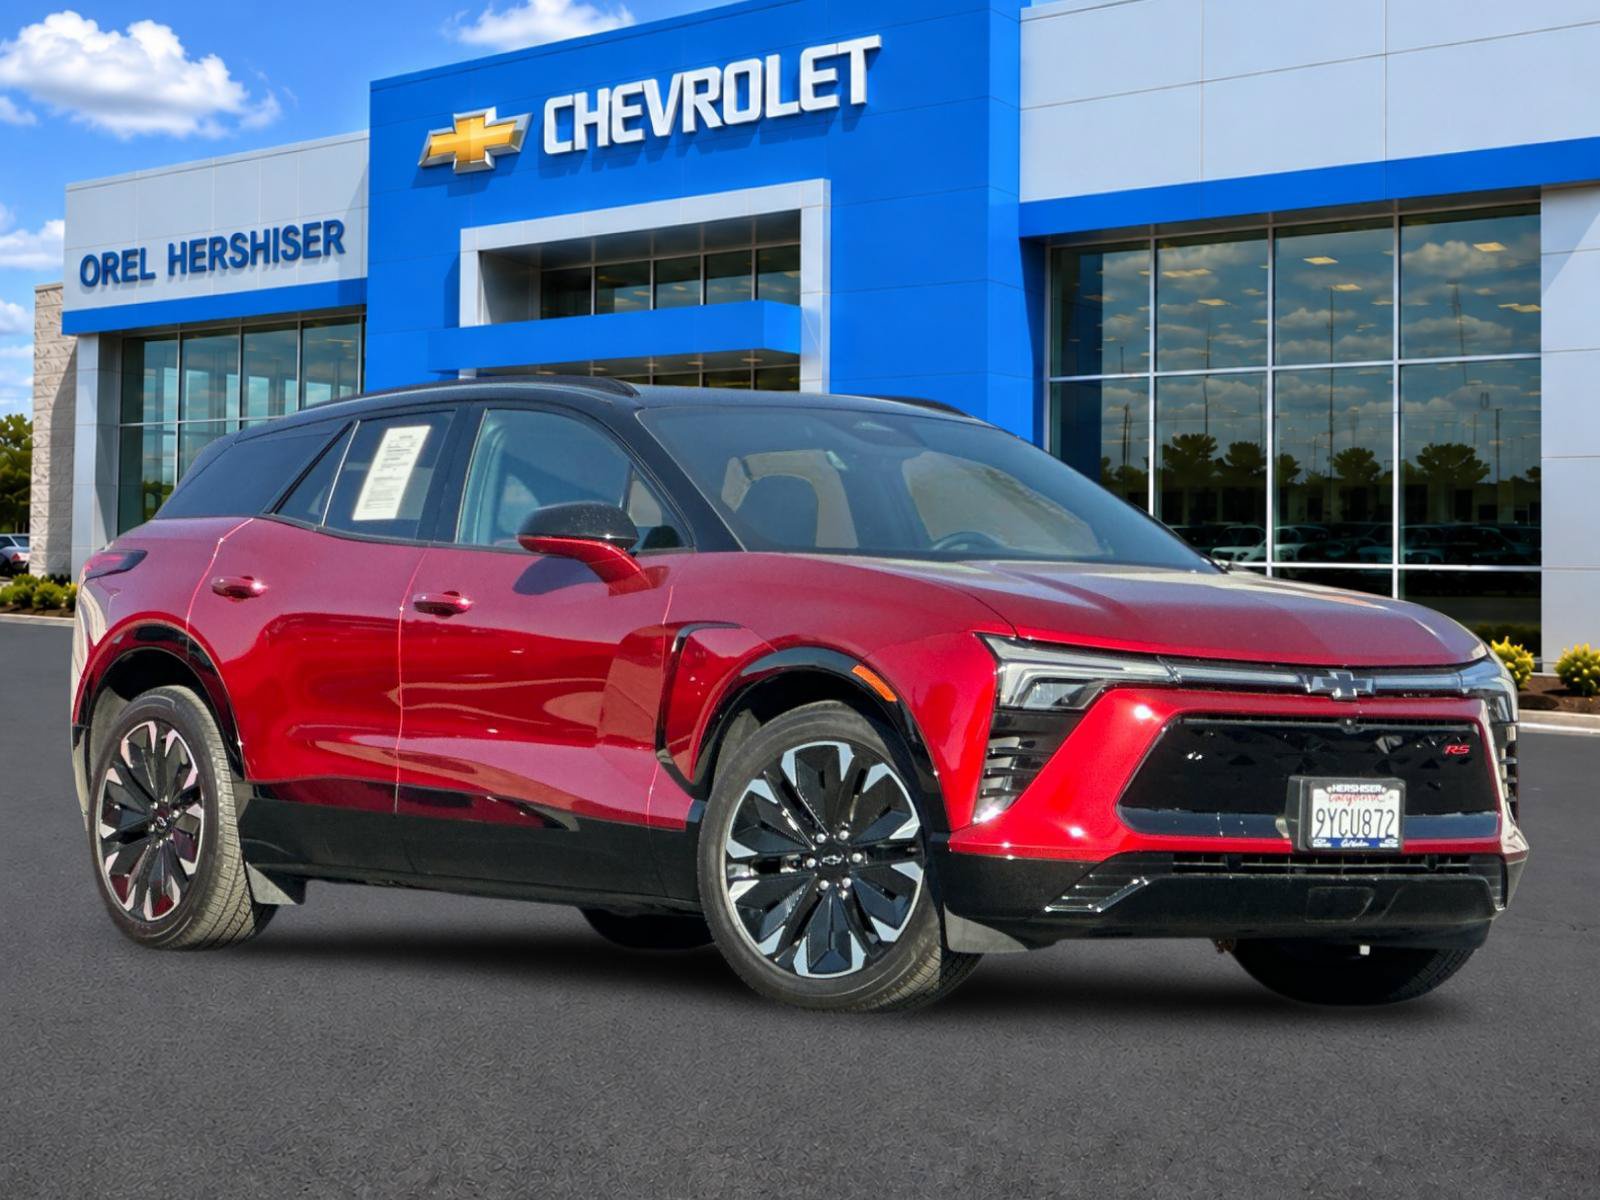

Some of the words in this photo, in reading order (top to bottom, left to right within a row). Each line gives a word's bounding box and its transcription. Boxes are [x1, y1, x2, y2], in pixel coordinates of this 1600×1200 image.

[543, 34, 881, 155] CHEVROLET
[80, 247, 156, 287] OREL
[168, 219, 346, 276] HERSHISER
[1444, 744, 1470, 755] RS
[1332, 784, 1382, 793] HERSHISER
[1315, 808, 1395, 839] 9YCU872
